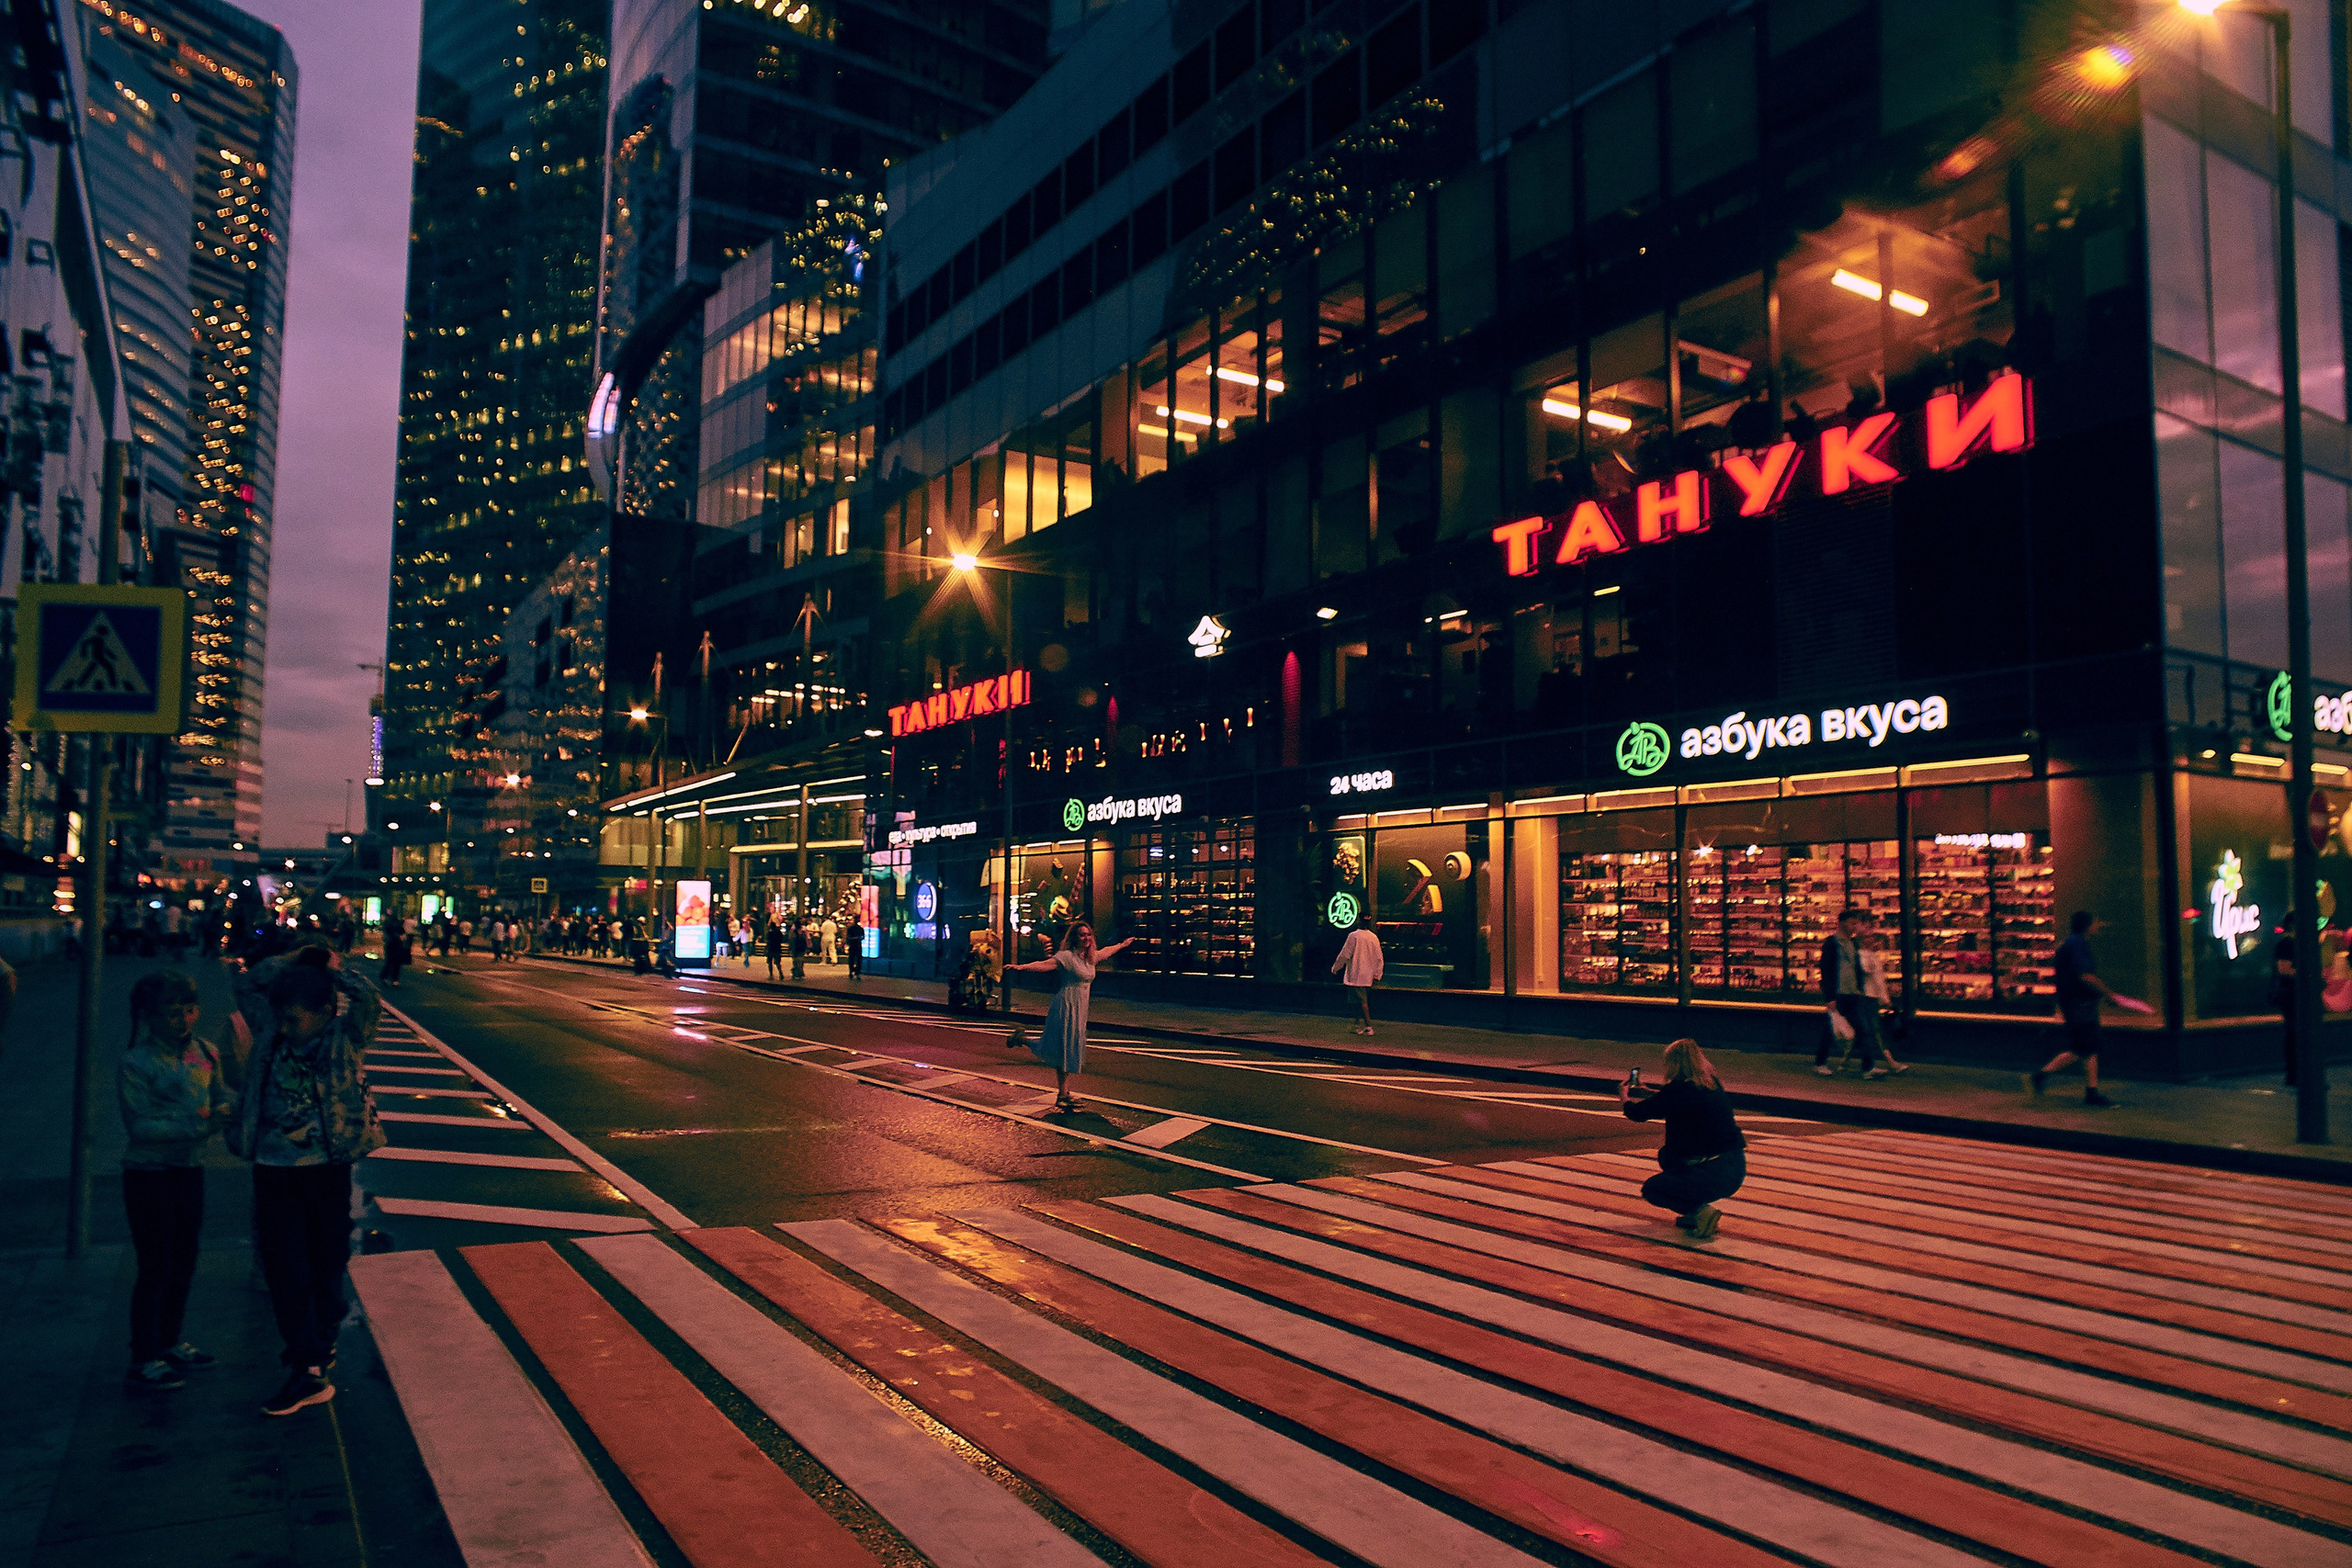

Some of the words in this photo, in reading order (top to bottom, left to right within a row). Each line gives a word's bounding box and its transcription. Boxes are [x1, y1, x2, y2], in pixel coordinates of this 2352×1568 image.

[1492, 373, 2035, 577] ТАНУКИ
[888, 670, 1031, 738] ТАНУКИ
[1679, 711, 1813, 761] азбука
[1820, 694, 1949, 748] вкуса
[1087, 795, 1136, 826] азбука
[1137, 794, 1182, 821] вкуса
[1329, 775, 1351, 795] 24
[1351, 770, 1394, 792] часа
